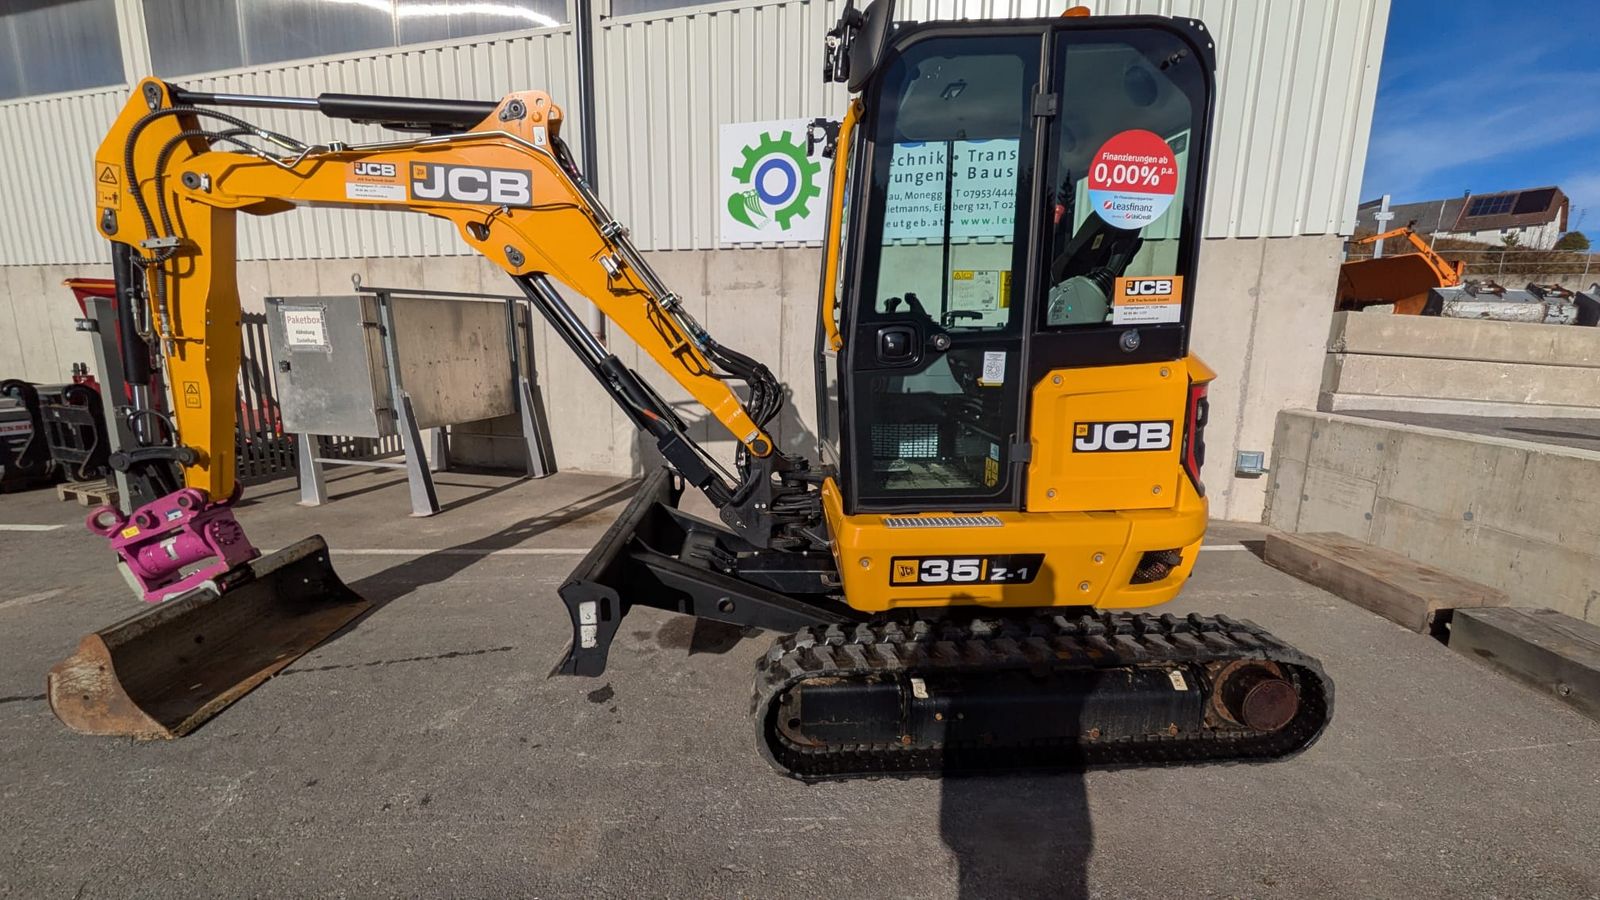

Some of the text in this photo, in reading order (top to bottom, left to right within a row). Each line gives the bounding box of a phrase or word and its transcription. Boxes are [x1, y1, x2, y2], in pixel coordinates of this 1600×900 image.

[968, 149, 1016, 162] Trans
[1102, 152, 1157, 164] Finanzierungen
[354, 163, 395, 177] JCB
[967, 167, 1013, 179] Baus
[1094, 163, 1174, 187] 0,00% p.a.
[413, 166, 530, 204] JCB
[904, 191, 943, 201] Monegg
[955, 189, 961, 198] T
[963, 188, 1016, 199] 07953/444
[976, 203, 991, 211] 121,
[993, 201, 999, 209] T
[1112, 201, 1153, 212] Leasfinanz
[1126, 280, 1172, 295] JCB
[286, 315, 320, 324] Paketbox
[1075, 423, 1171, 451] JCB
[920, 559, 980, 582] 35
[990, 567, 1028, 581] Z-1
